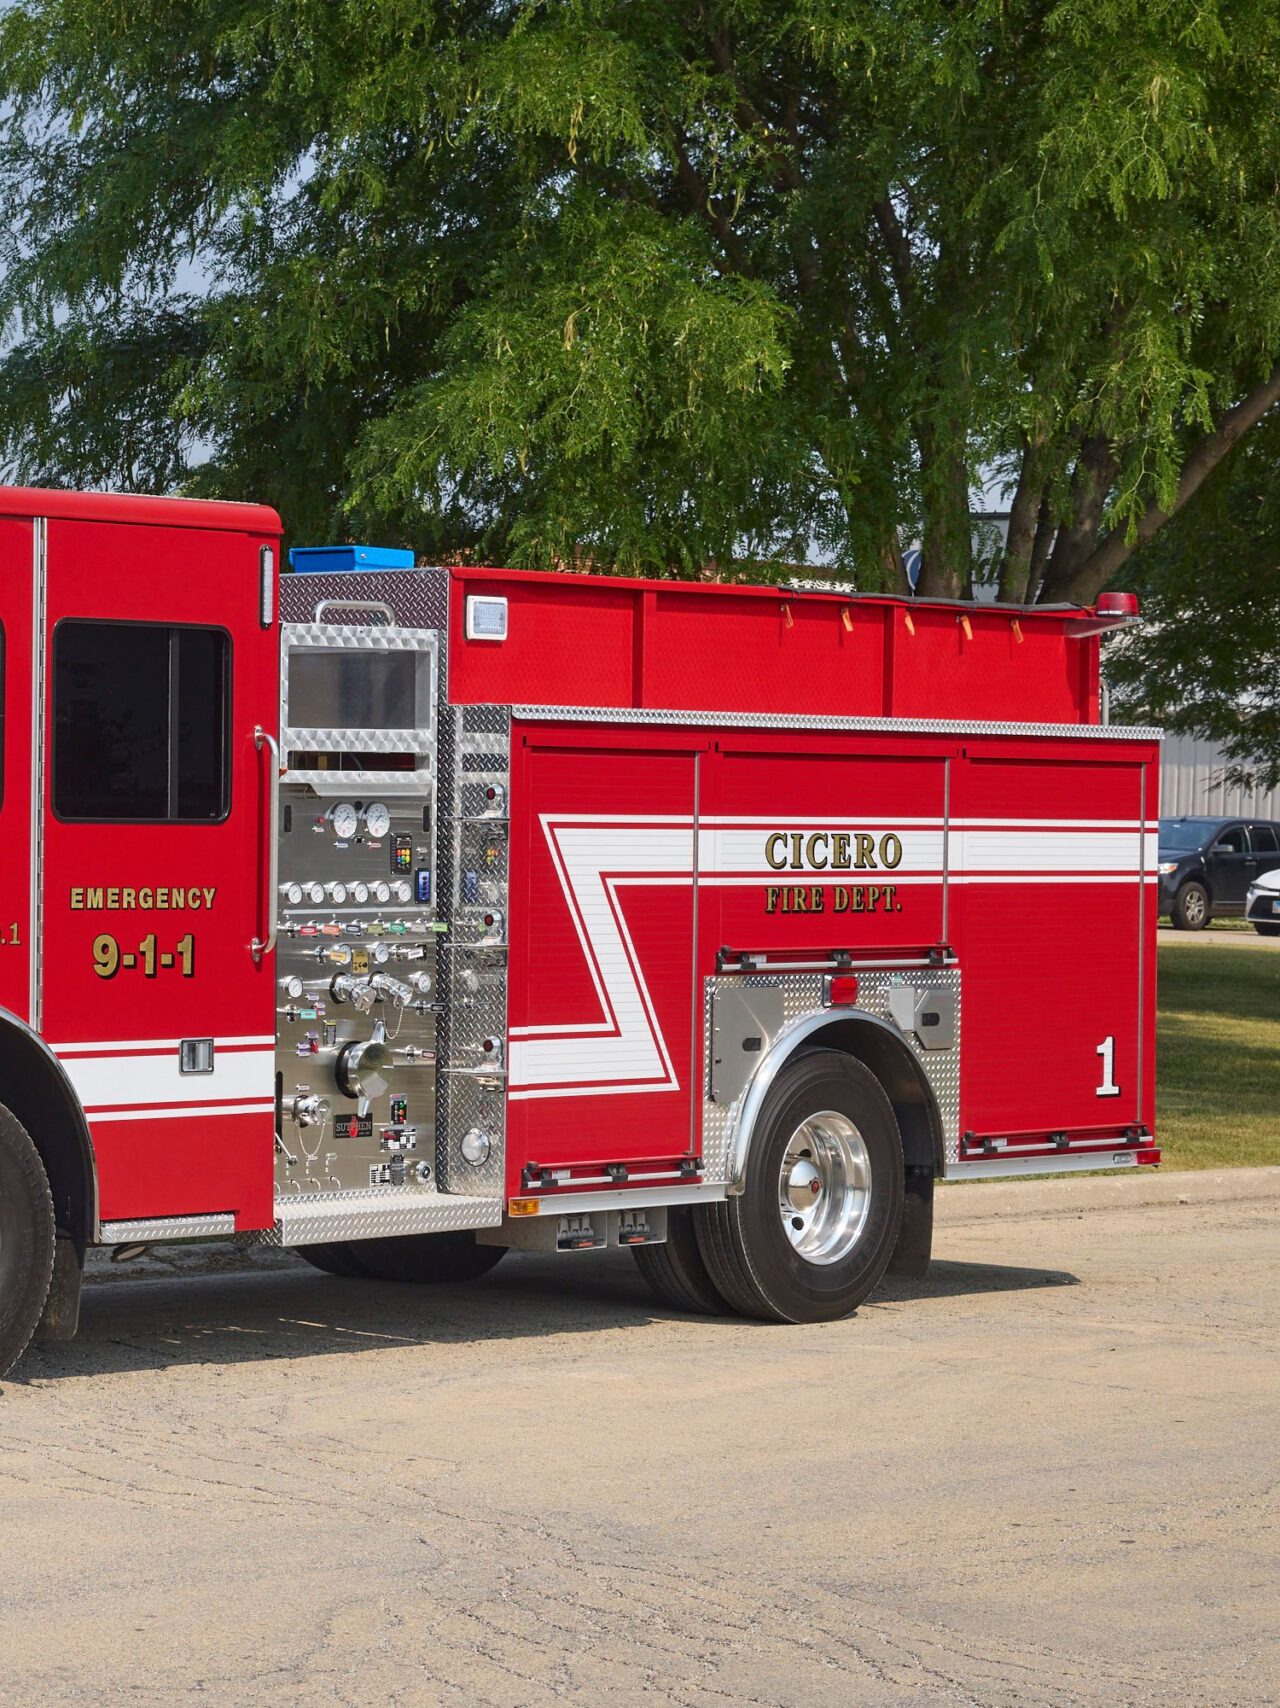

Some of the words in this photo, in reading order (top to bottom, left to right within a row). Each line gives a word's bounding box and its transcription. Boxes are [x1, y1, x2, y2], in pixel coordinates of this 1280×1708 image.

[765, 832, 903, 869] CICERO
[70, 887, 217, 911] EMERGENCY
[765, 886, 824, 914] FIRE
[832, 886, 903, 913] DEPT.
[92, 934, 196, 979] 9-1-1
[1096, 1035, 1121, 1097] 1
